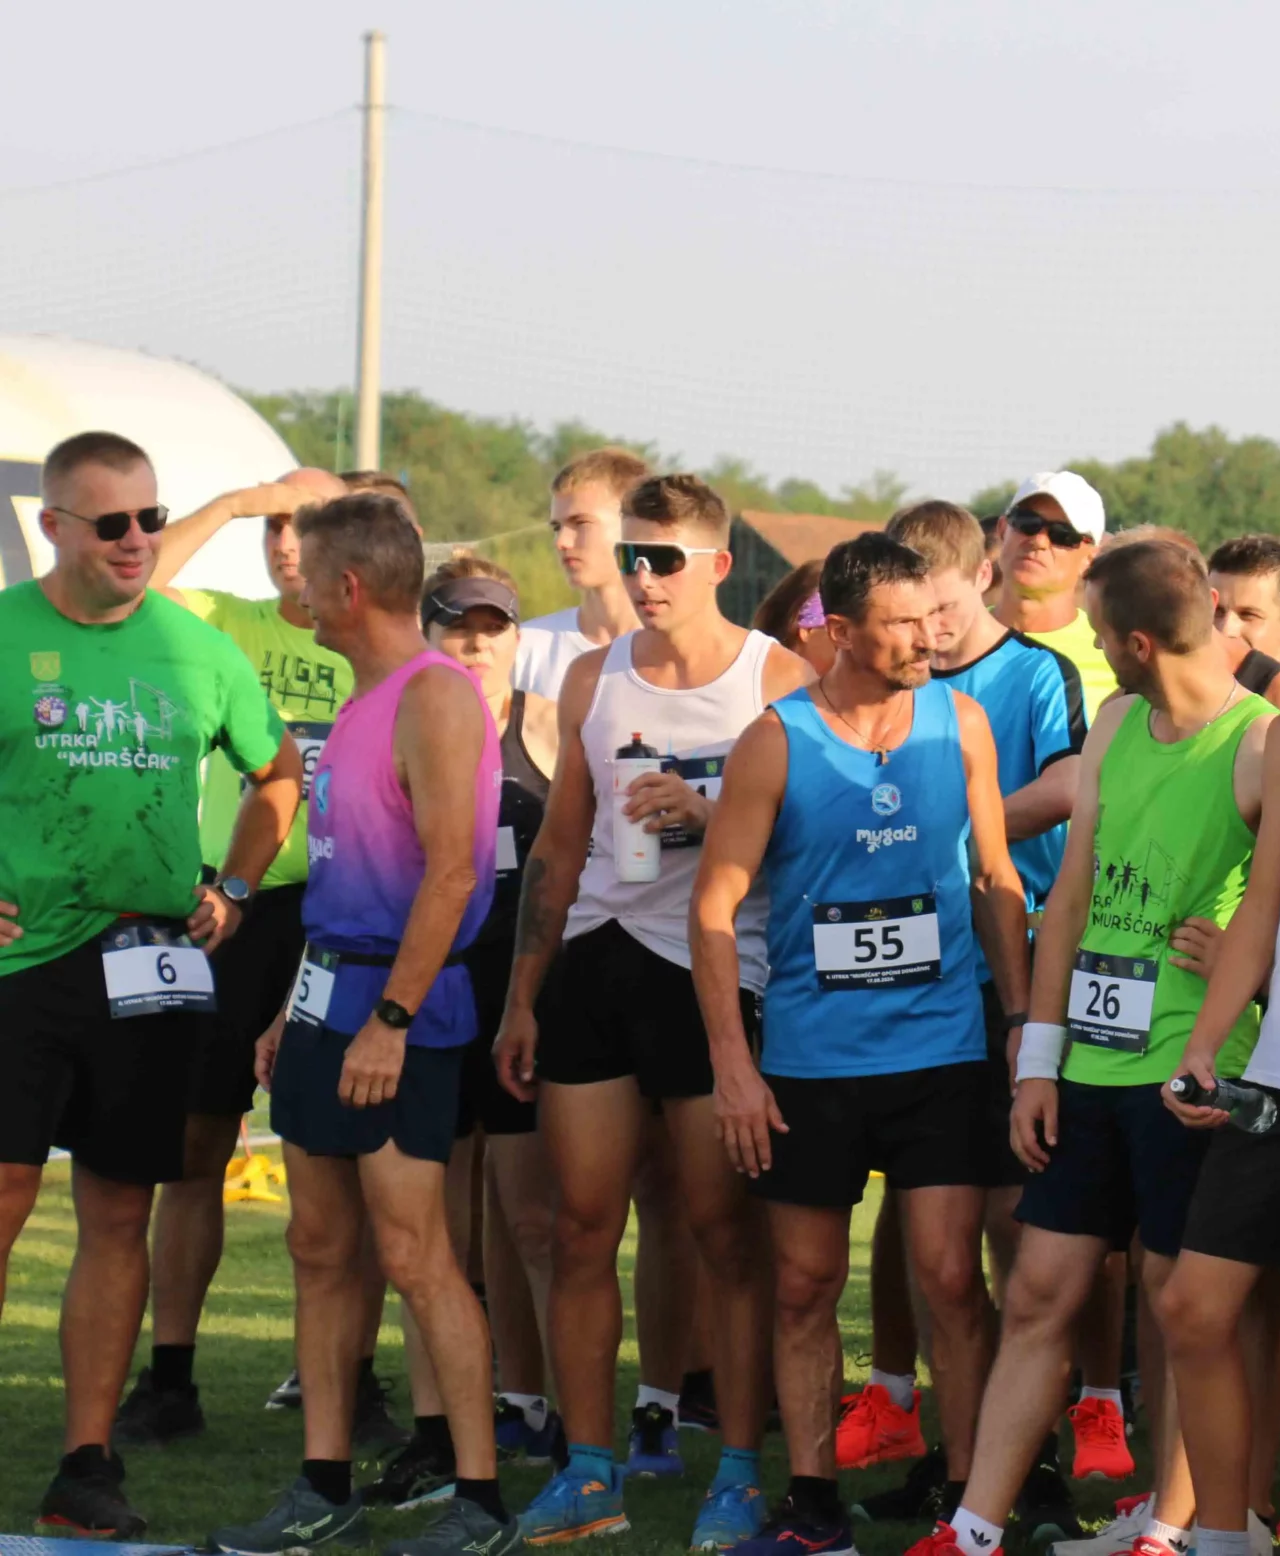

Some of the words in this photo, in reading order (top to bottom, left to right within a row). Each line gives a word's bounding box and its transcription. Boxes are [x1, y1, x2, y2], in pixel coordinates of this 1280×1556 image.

[35, 733, 98, 749] UTRKA
[303, 745, 321, 775] 6
[856, 825, 916, 853] mugači
[854, 925, 904, 963] 55
[156, 951, 177, 985] 6
[1085, 980, 1120, 1020] 26
